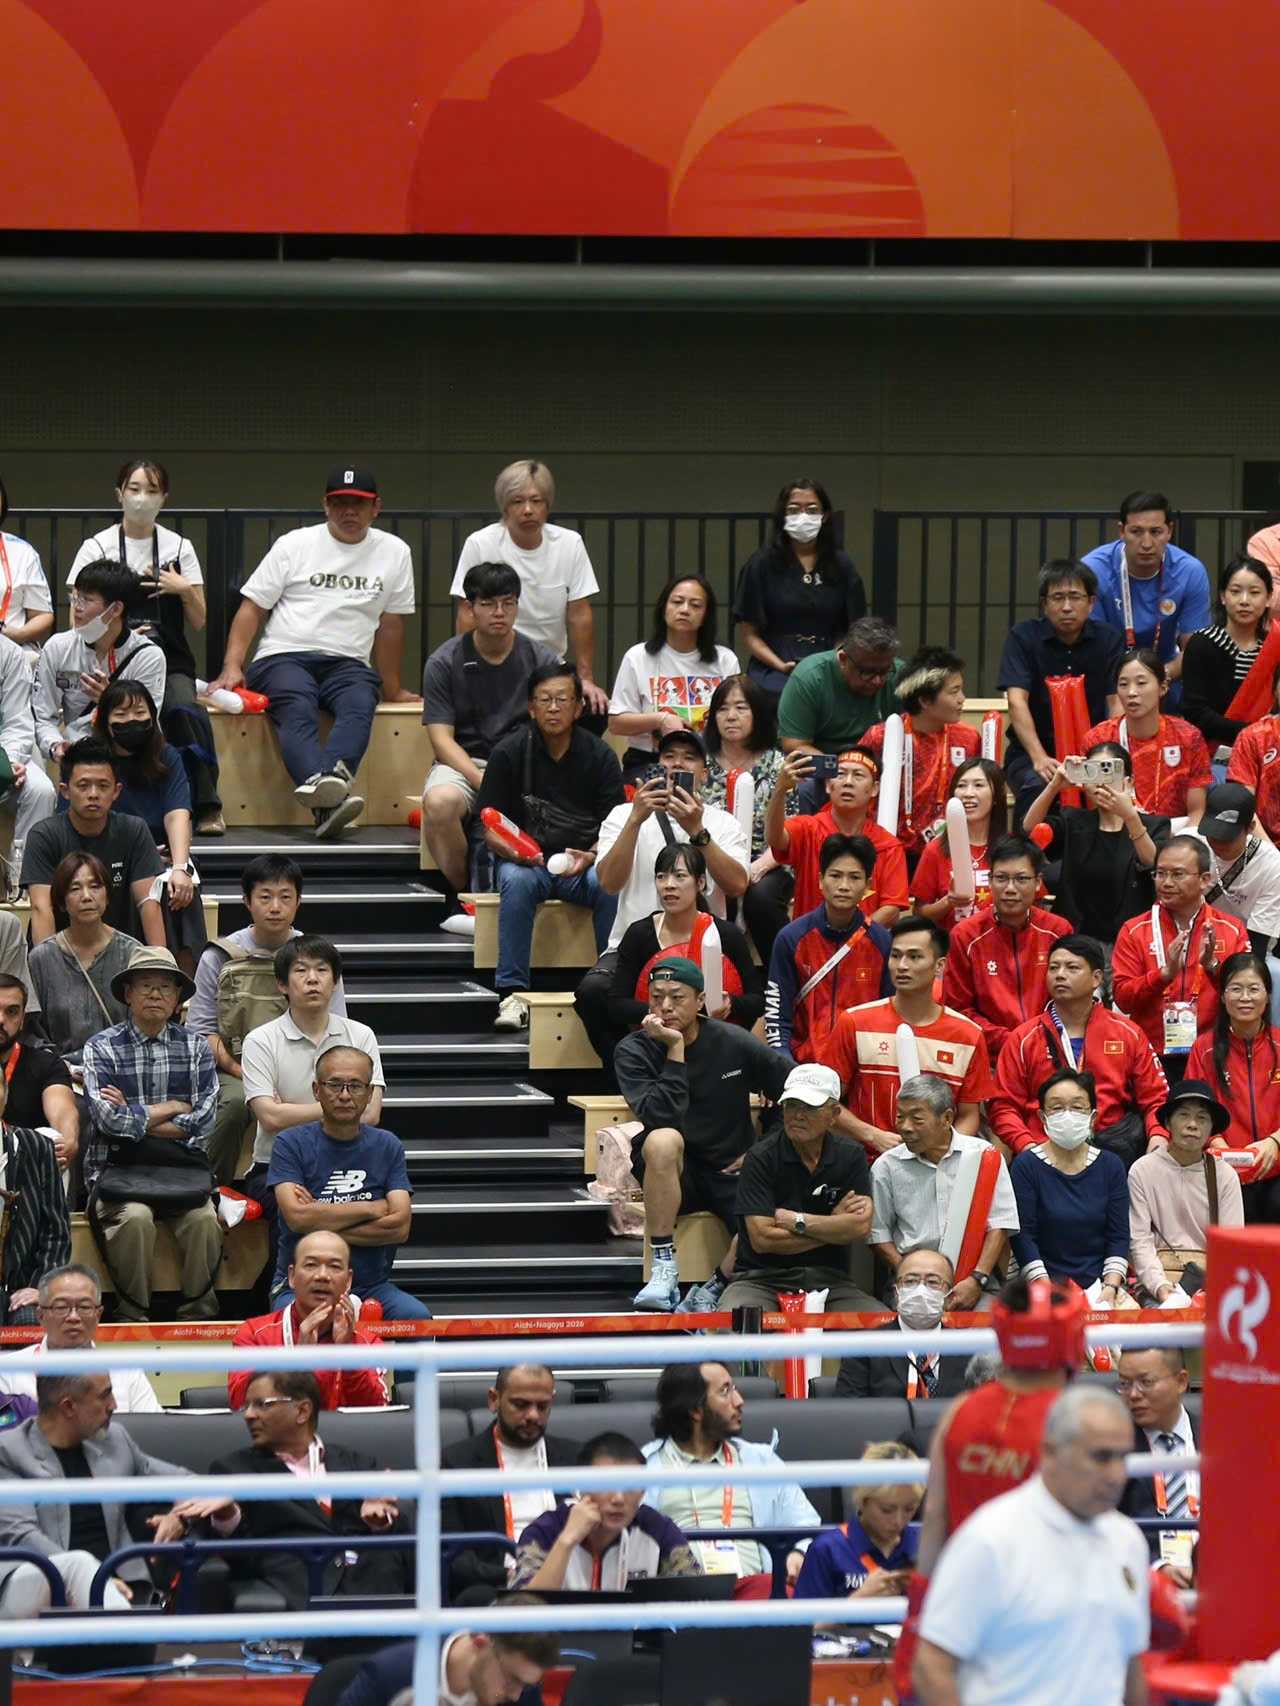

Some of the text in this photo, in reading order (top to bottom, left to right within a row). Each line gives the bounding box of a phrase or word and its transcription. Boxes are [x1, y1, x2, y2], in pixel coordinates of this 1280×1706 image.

[1091, 1313, 1109, 1321] 2026
[398, 1324, 416, 1332] 2026
[514, 1320, 584, 1330] Aichi-Nagoya 2026
[957, 1443, 1032, 1480] CHN
